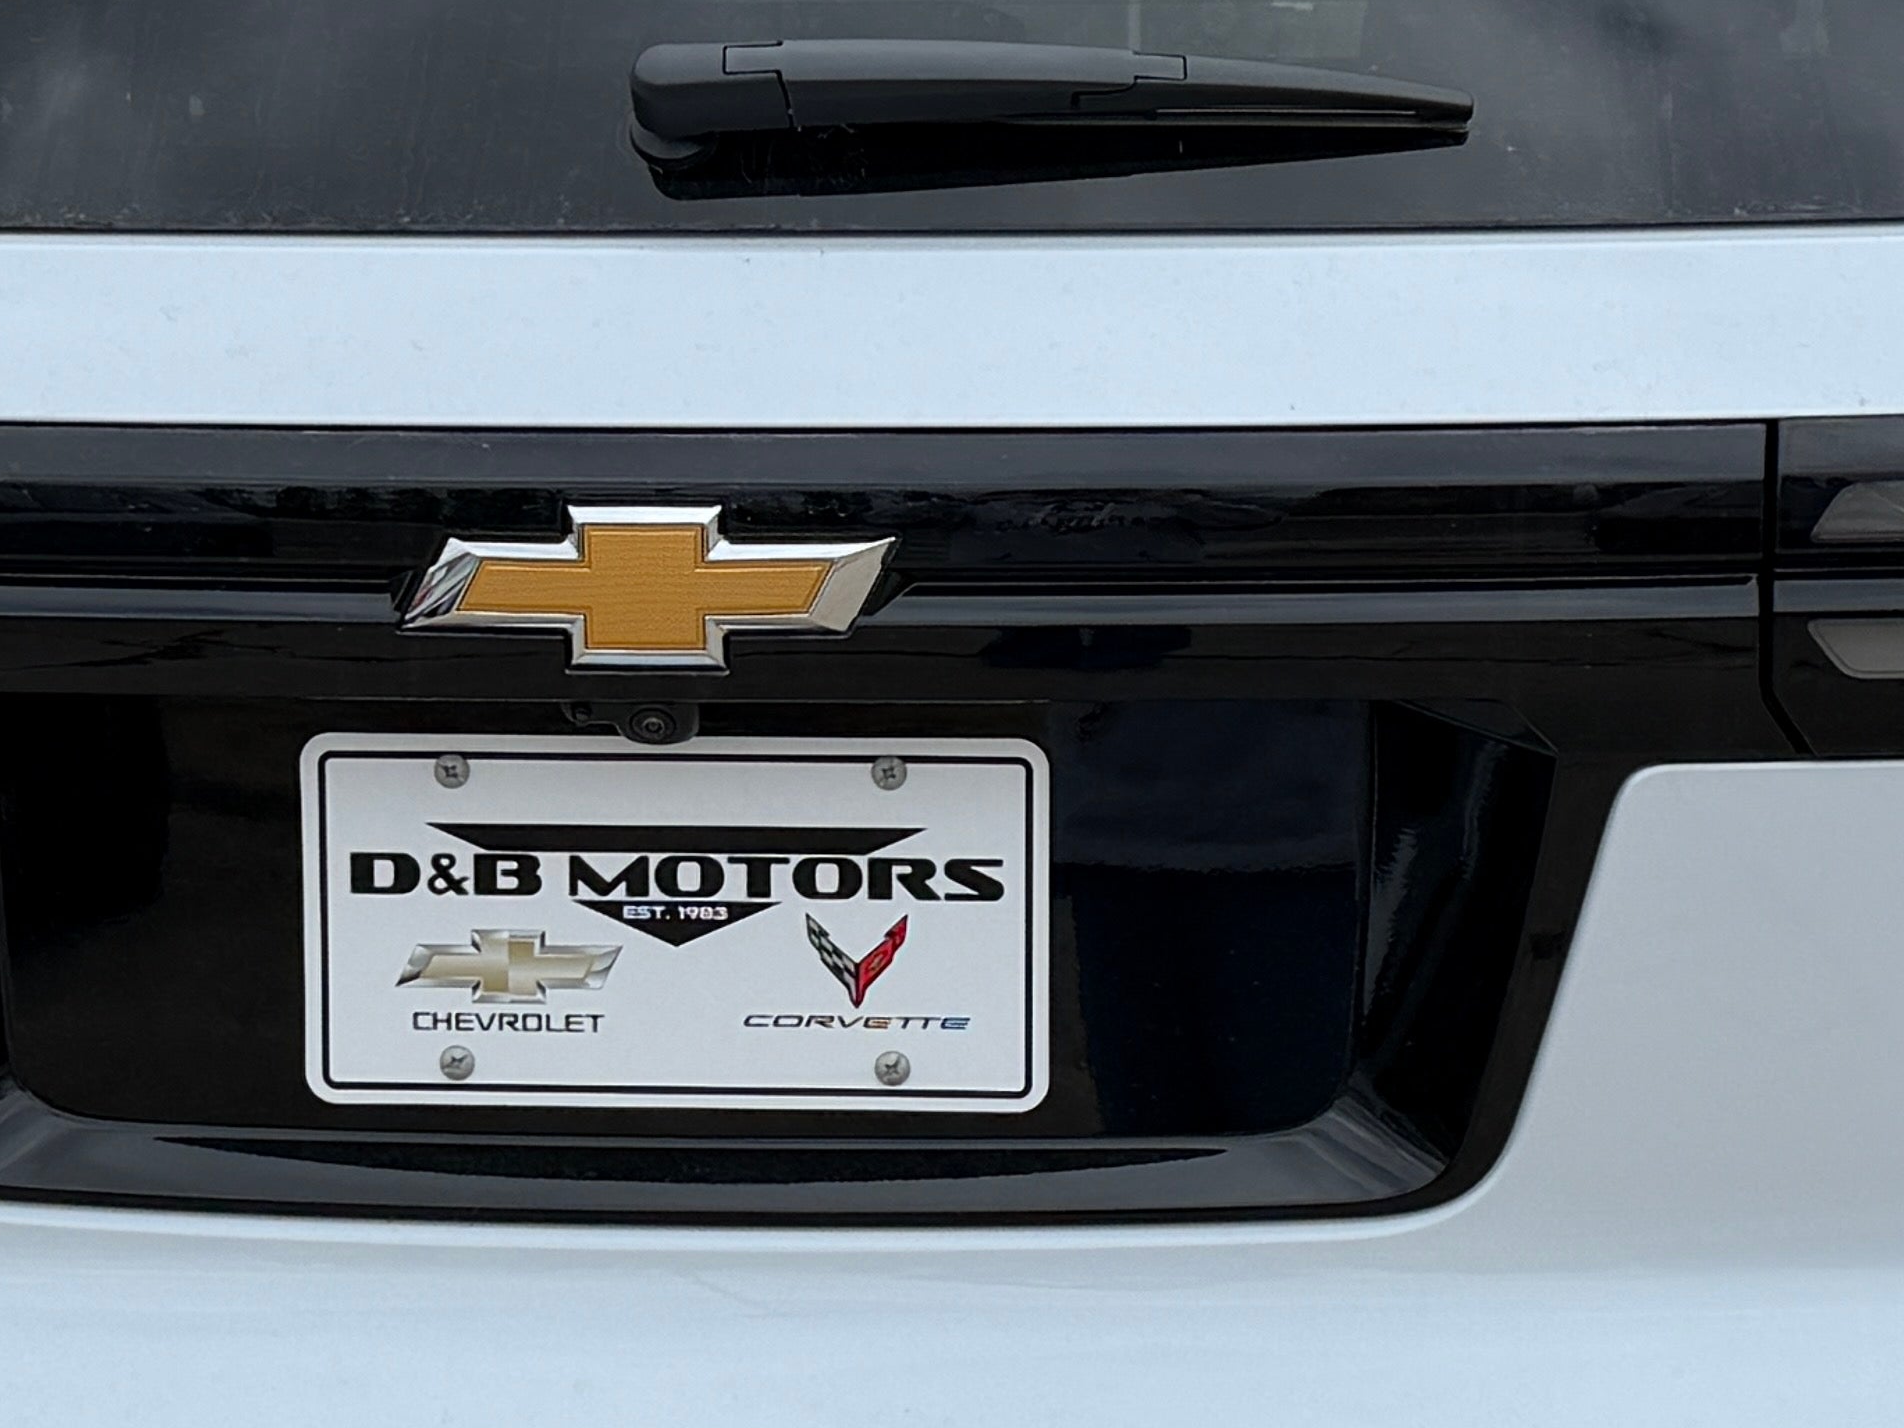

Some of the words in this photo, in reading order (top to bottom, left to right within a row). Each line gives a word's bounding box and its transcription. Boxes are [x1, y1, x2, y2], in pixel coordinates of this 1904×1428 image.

[348, 851, 543, 898] D&B
[568, 854, 1006, 902] MOTORS
[622, 905, 671, 921] EST.
[677, 905, 729, 921] 1983
[412, 1011, 605, 1033] CHEVROLET
[743, 1014, 971, 1031] CORVETTE
